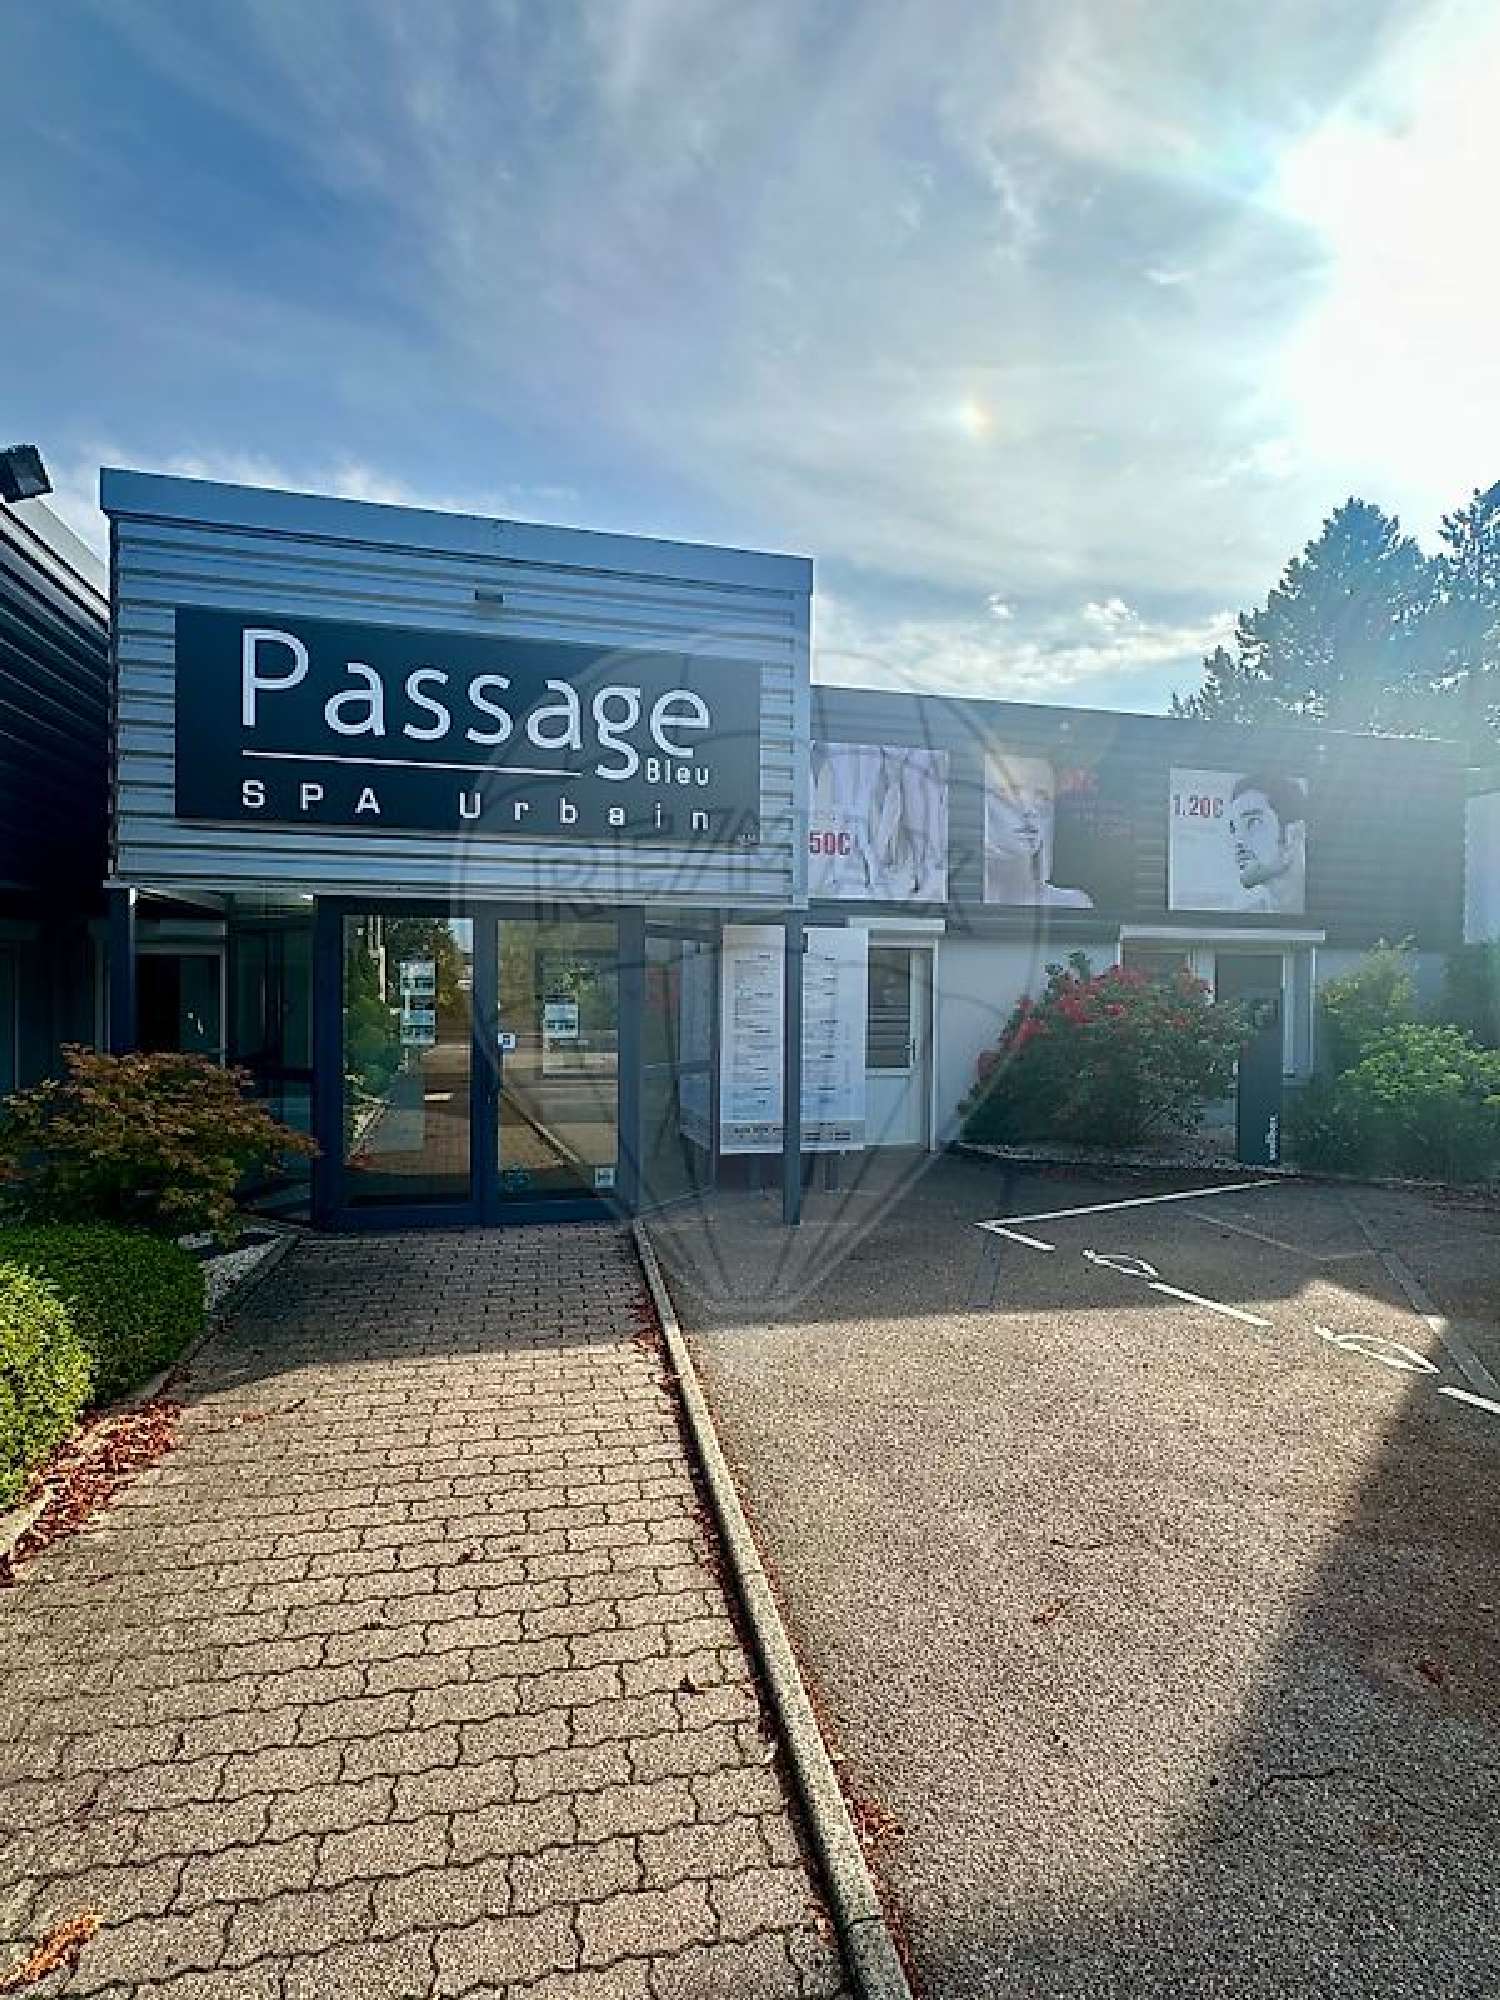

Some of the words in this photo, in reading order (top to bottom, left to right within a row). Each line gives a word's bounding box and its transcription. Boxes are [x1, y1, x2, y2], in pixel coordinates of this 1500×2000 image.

[242, 629, 710, 779] Passage
[647, 757, 709, 785] Bleu
[242, 779, 381, 814] SPA
[459, 792, 709, 830] Urbain
